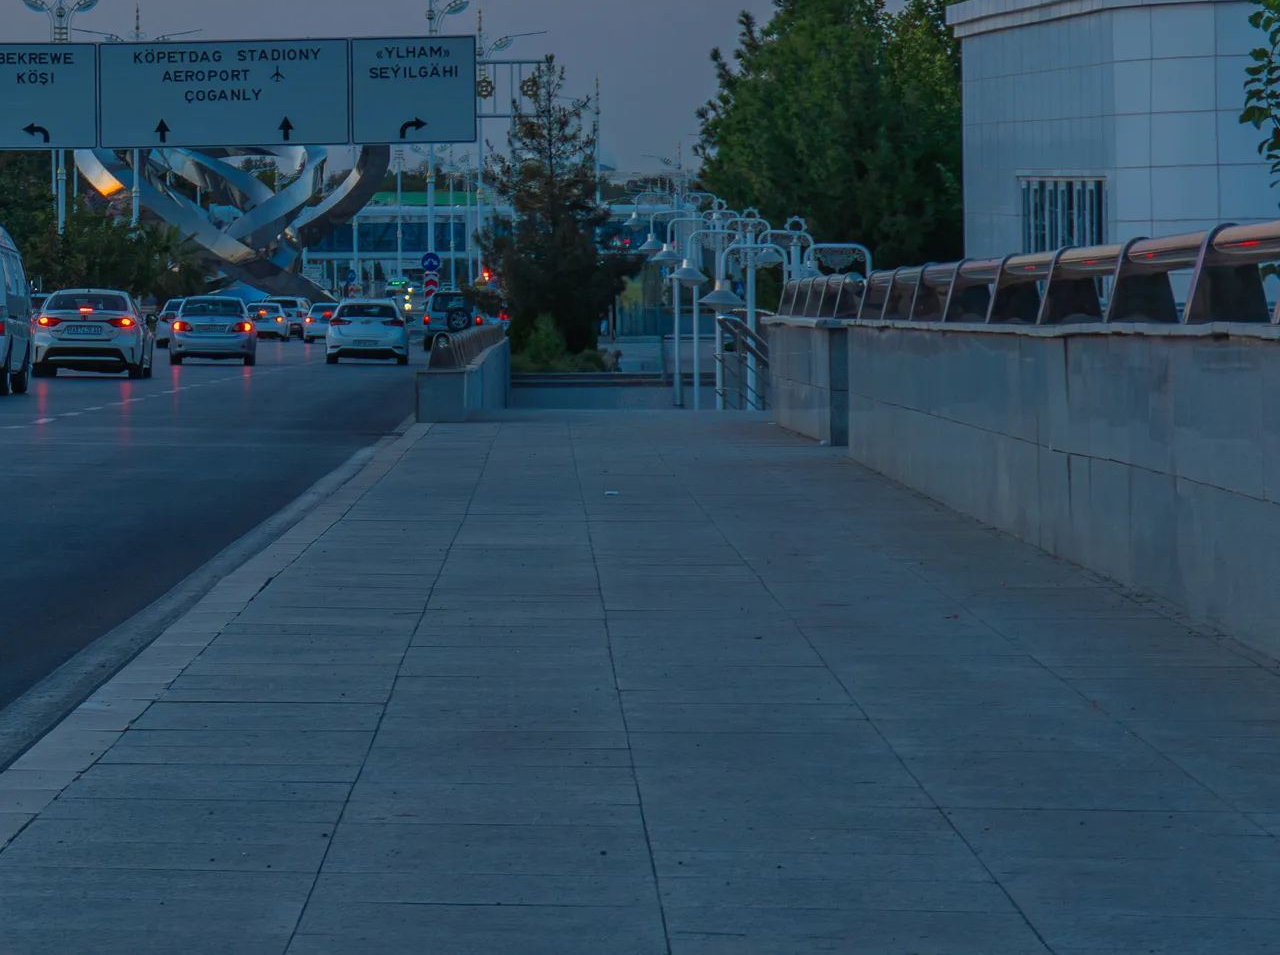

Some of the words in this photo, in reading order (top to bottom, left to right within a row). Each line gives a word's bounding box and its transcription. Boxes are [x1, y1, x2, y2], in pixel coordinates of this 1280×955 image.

[133, 49, 223, 64] KÖPETDAG
[237, 48, 322, 62] STADIONY
[16, 69, 55, 85] KÖŞI
[161, 69, 250, 83] AEROPORT
[184, 88, 262, 104] ÇOGANLY
